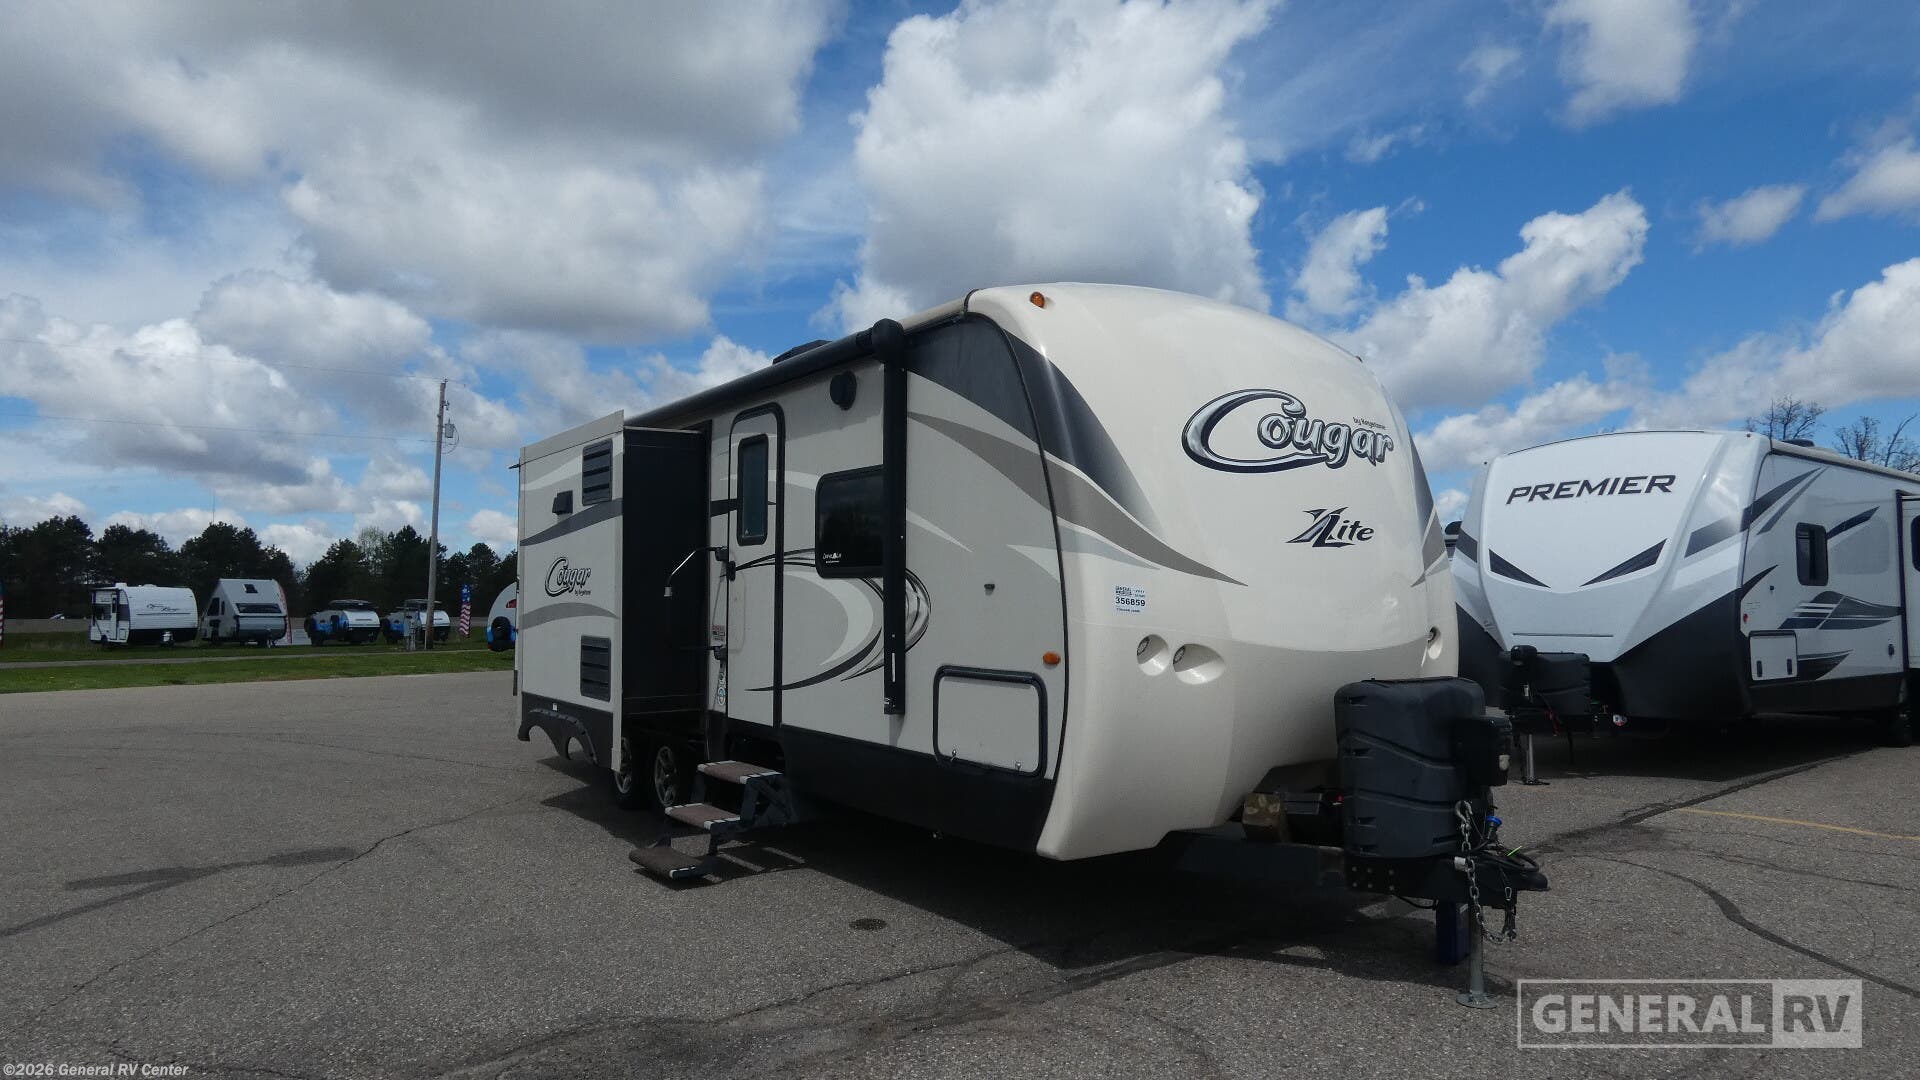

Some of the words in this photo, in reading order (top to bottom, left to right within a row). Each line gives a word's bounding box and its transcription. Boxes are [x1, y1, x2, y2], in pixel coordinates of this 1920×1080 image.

[1181, 388, 1394, 474] Cougar
[1506, 475, 1676, 505] PREMIER
[545, 556, 591, 597] Cougar
[1115, 596, 1146, 607] 356859
